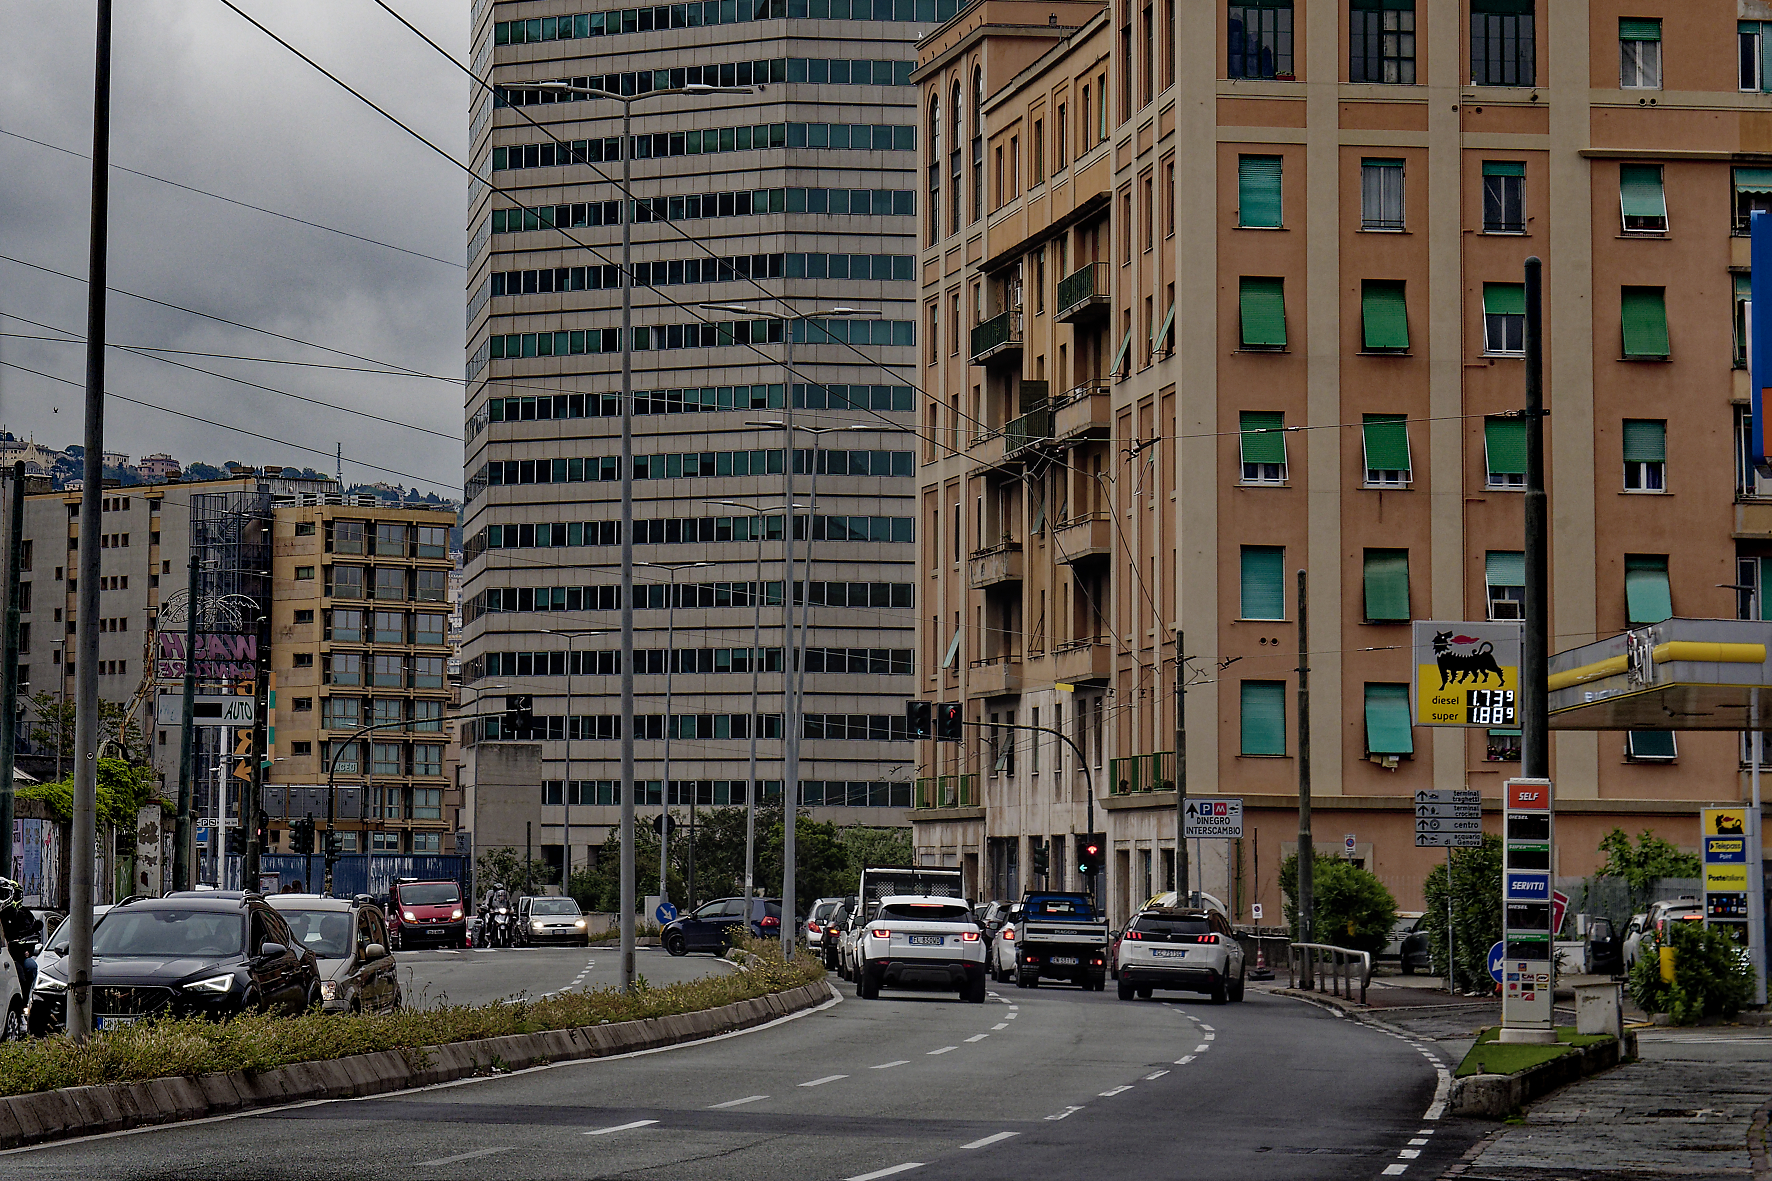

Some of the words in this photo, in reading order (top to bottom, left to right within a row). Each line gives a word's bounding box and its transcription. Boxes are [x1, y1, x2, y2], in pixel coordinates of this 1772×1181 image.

[1432, 696, 1459, 705] diesel
[224, 701, 253, 720] AUTO
[1432, 713, 1458, 721] super
[1518, 792, 1539, 801] SELF
[1453, 821, 1479, 829] centro
[1714, 842, 1741, 851] Telepass
[1511, 881, 1545, 891] SERVITO
